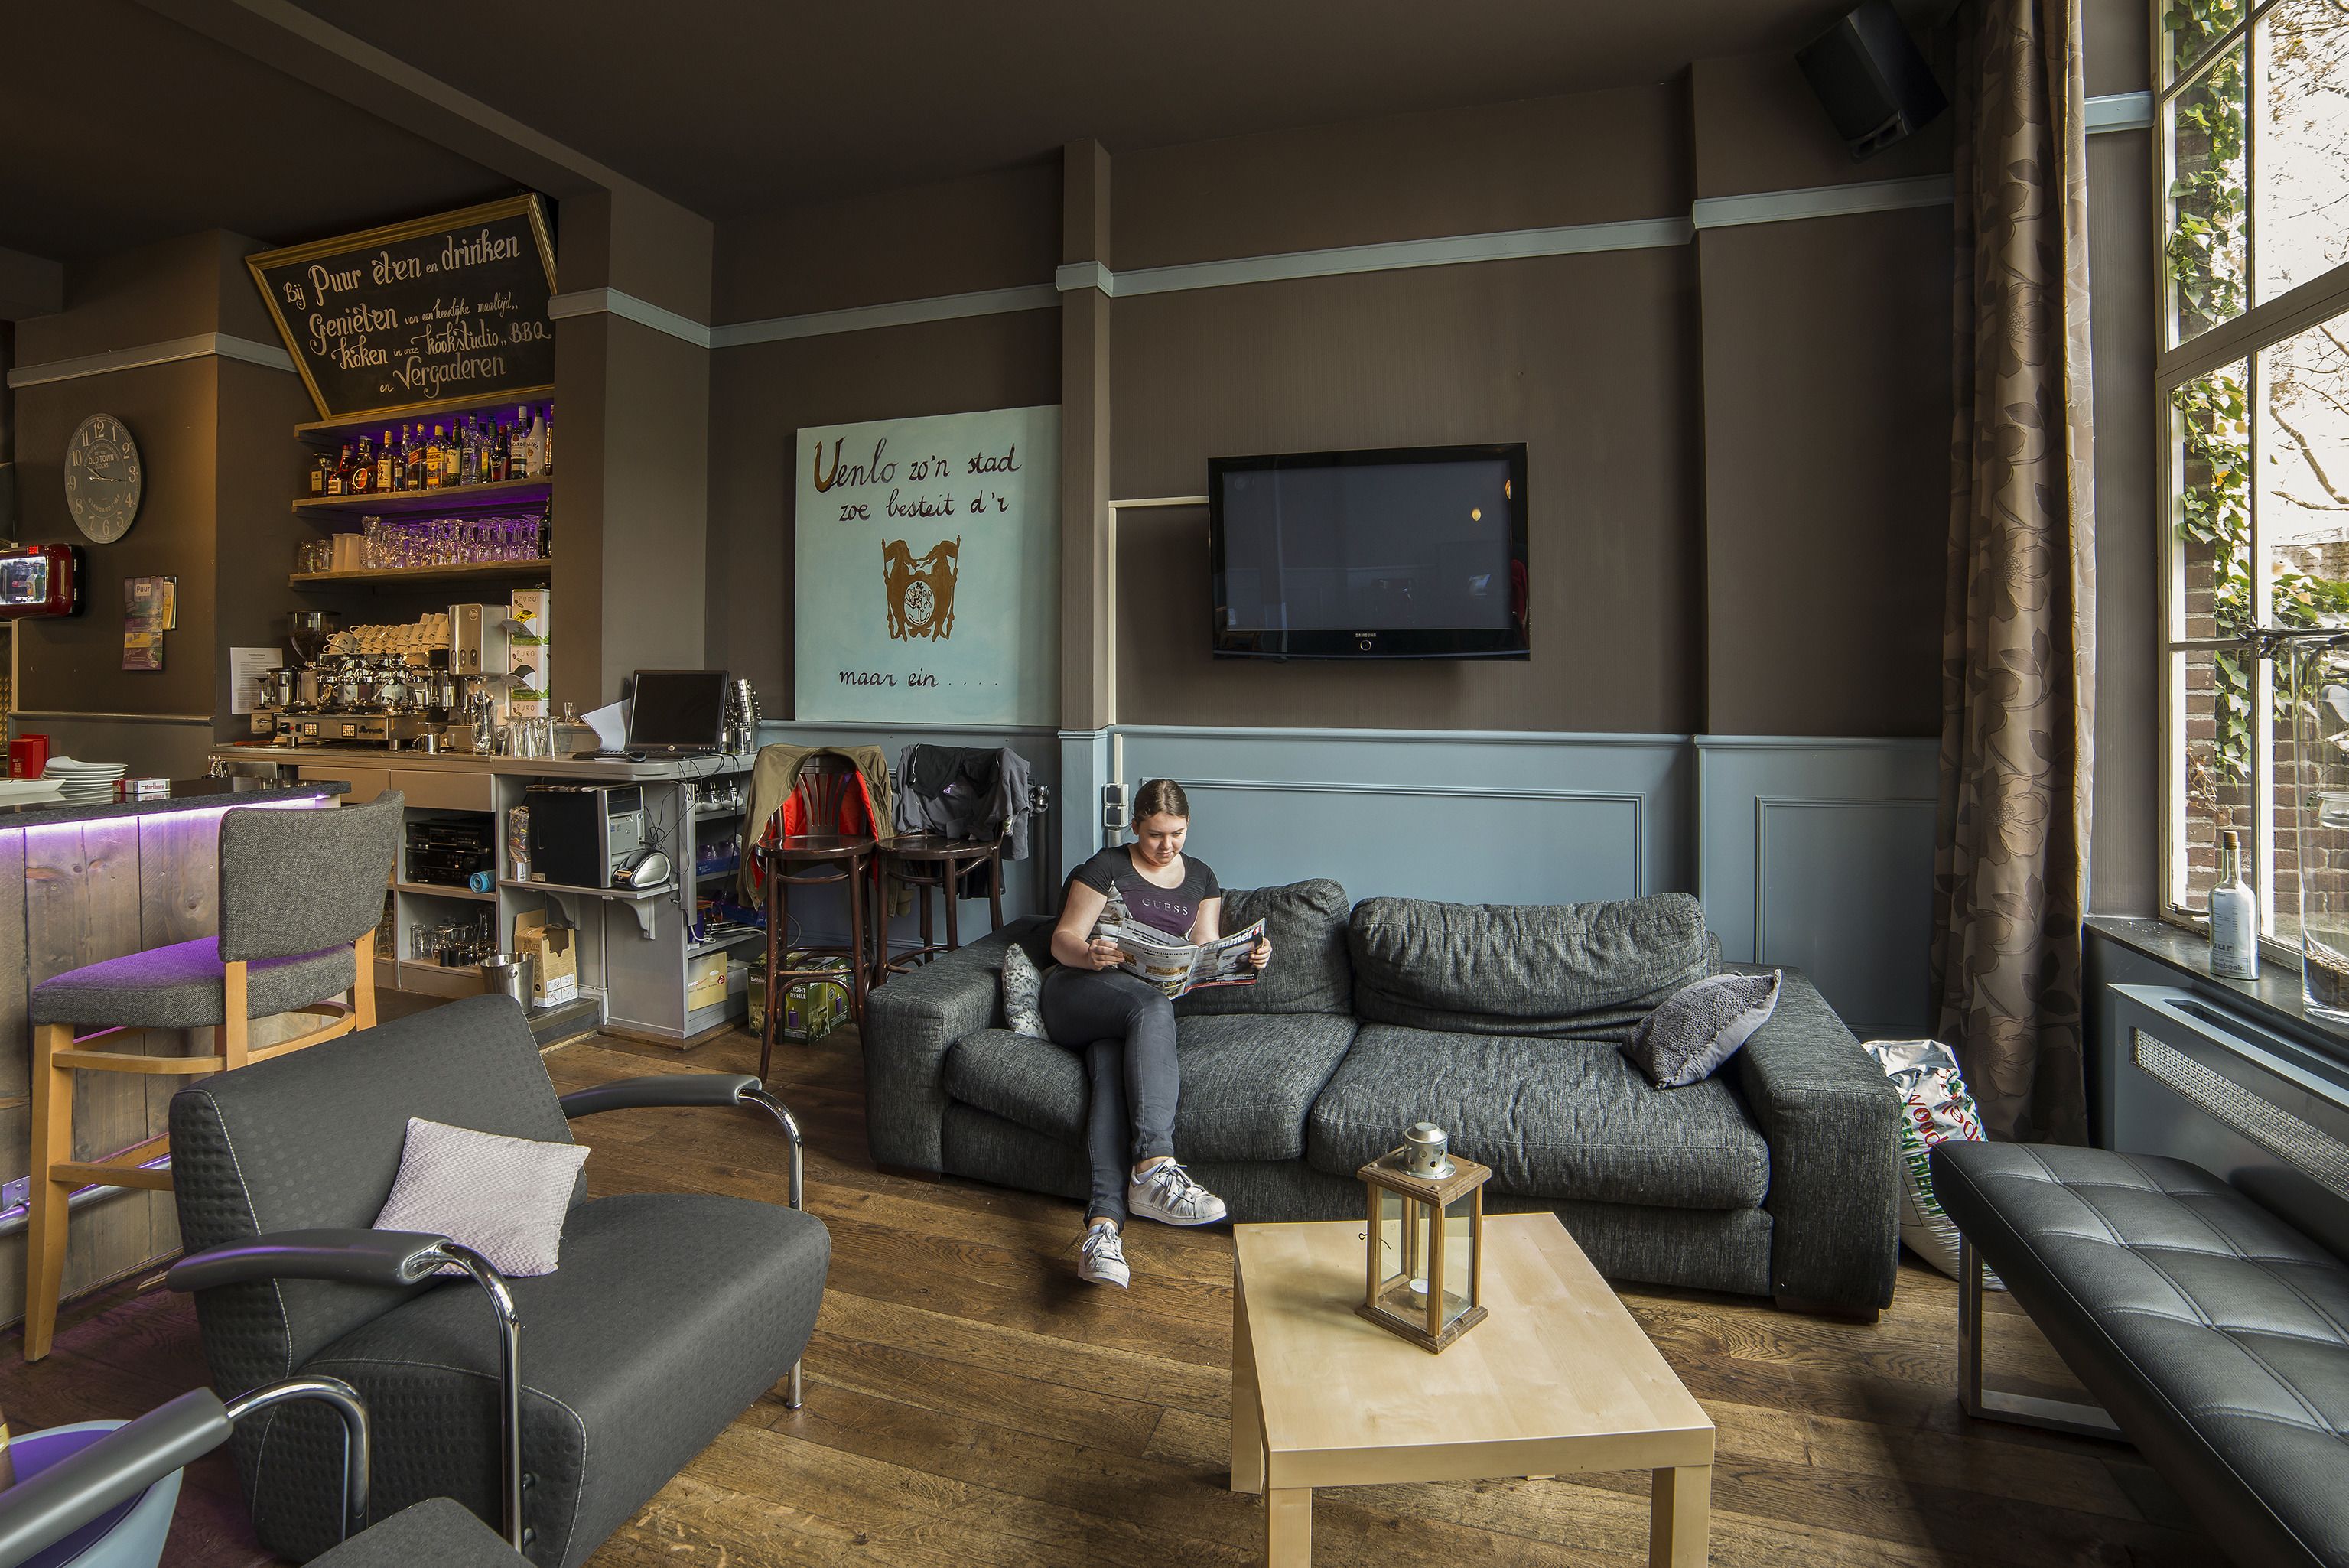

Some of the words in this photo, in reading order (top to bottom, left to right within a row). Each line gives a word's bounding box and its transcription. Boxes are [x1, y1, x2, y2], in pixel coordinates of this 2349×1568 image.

[283, 281, 306, 311] Bij
[308, 265, 362, 307] Puur
[425, 263, 439, 273] en
[441, 229, 521, 271] drinken
[309, 303, 399, 356] Genieten
[405, 315, 419, 325] van
[422, 311, 434, 322] een
[433, 298, 471, 324] heerlijke
[330, 334, 389, 370] koken
[509, 321, 552, 343] BBQ
[379, 384, 394, 392] en
[392, 352, 506, 399] Vergaderen
[94, 421, 105, 438] 12
[112, 425, 116, 441] 1
[81, 430, 89, 447] 11
[70, 449, 82, 467] 10
[122, 442, 130, 459] 2
[89, 456, 99, 465] OLD
[99, 454, 114, 463] TOWN
[909, 454, 950, 482] zo'n
[967, 443, 1023, 475] stad
[129, 465, 136, 483] 3
[70, 475, 76, 491] 9
[75, 498, 83, 515] 8
[88, 497, 112, 513] STANDARD
[111, 493, 121, 509] TIME
[125, 493, 133, 508] 4
[839, 502, 871, 522] zoe
[886, 488, 955, 518] besteit
[88, 515, 96, 531] 7
[102, 519, 109, 535] 6
[116, 511, 123, 528] 5
[839, 669, 898, 687] maar
[908, 667, 939, 688] ein
[1141, 898, 1189, 916] GUESS
